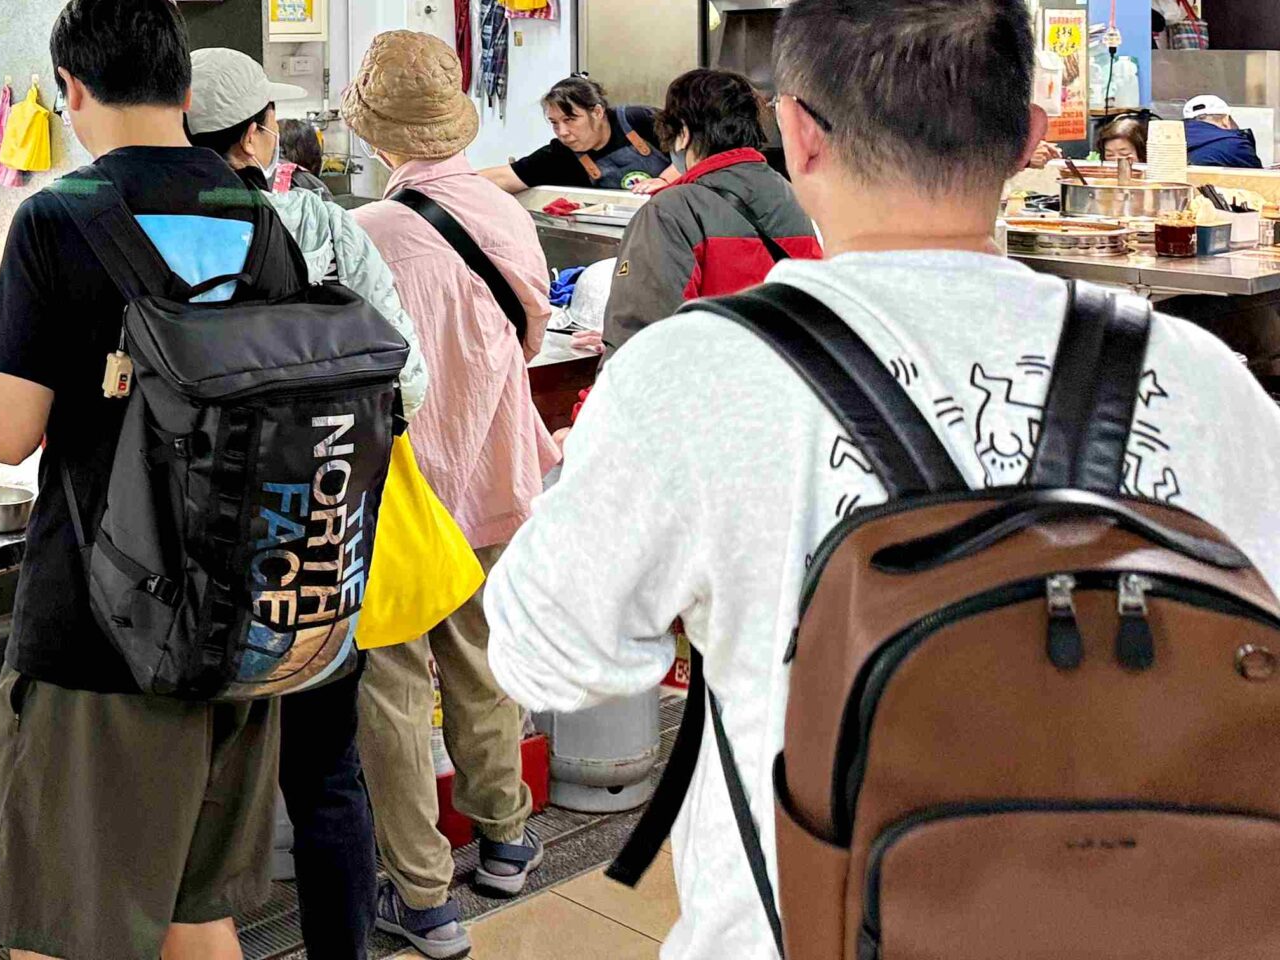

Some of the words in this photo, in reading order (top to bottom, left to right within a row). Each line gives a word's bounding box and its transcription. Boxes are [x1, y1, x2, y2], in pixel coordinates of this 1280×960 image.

[250, 482, 311, 626] FACE
[298, 413, 355, 625] NORTH
[338, 490, 367, 616] THE
